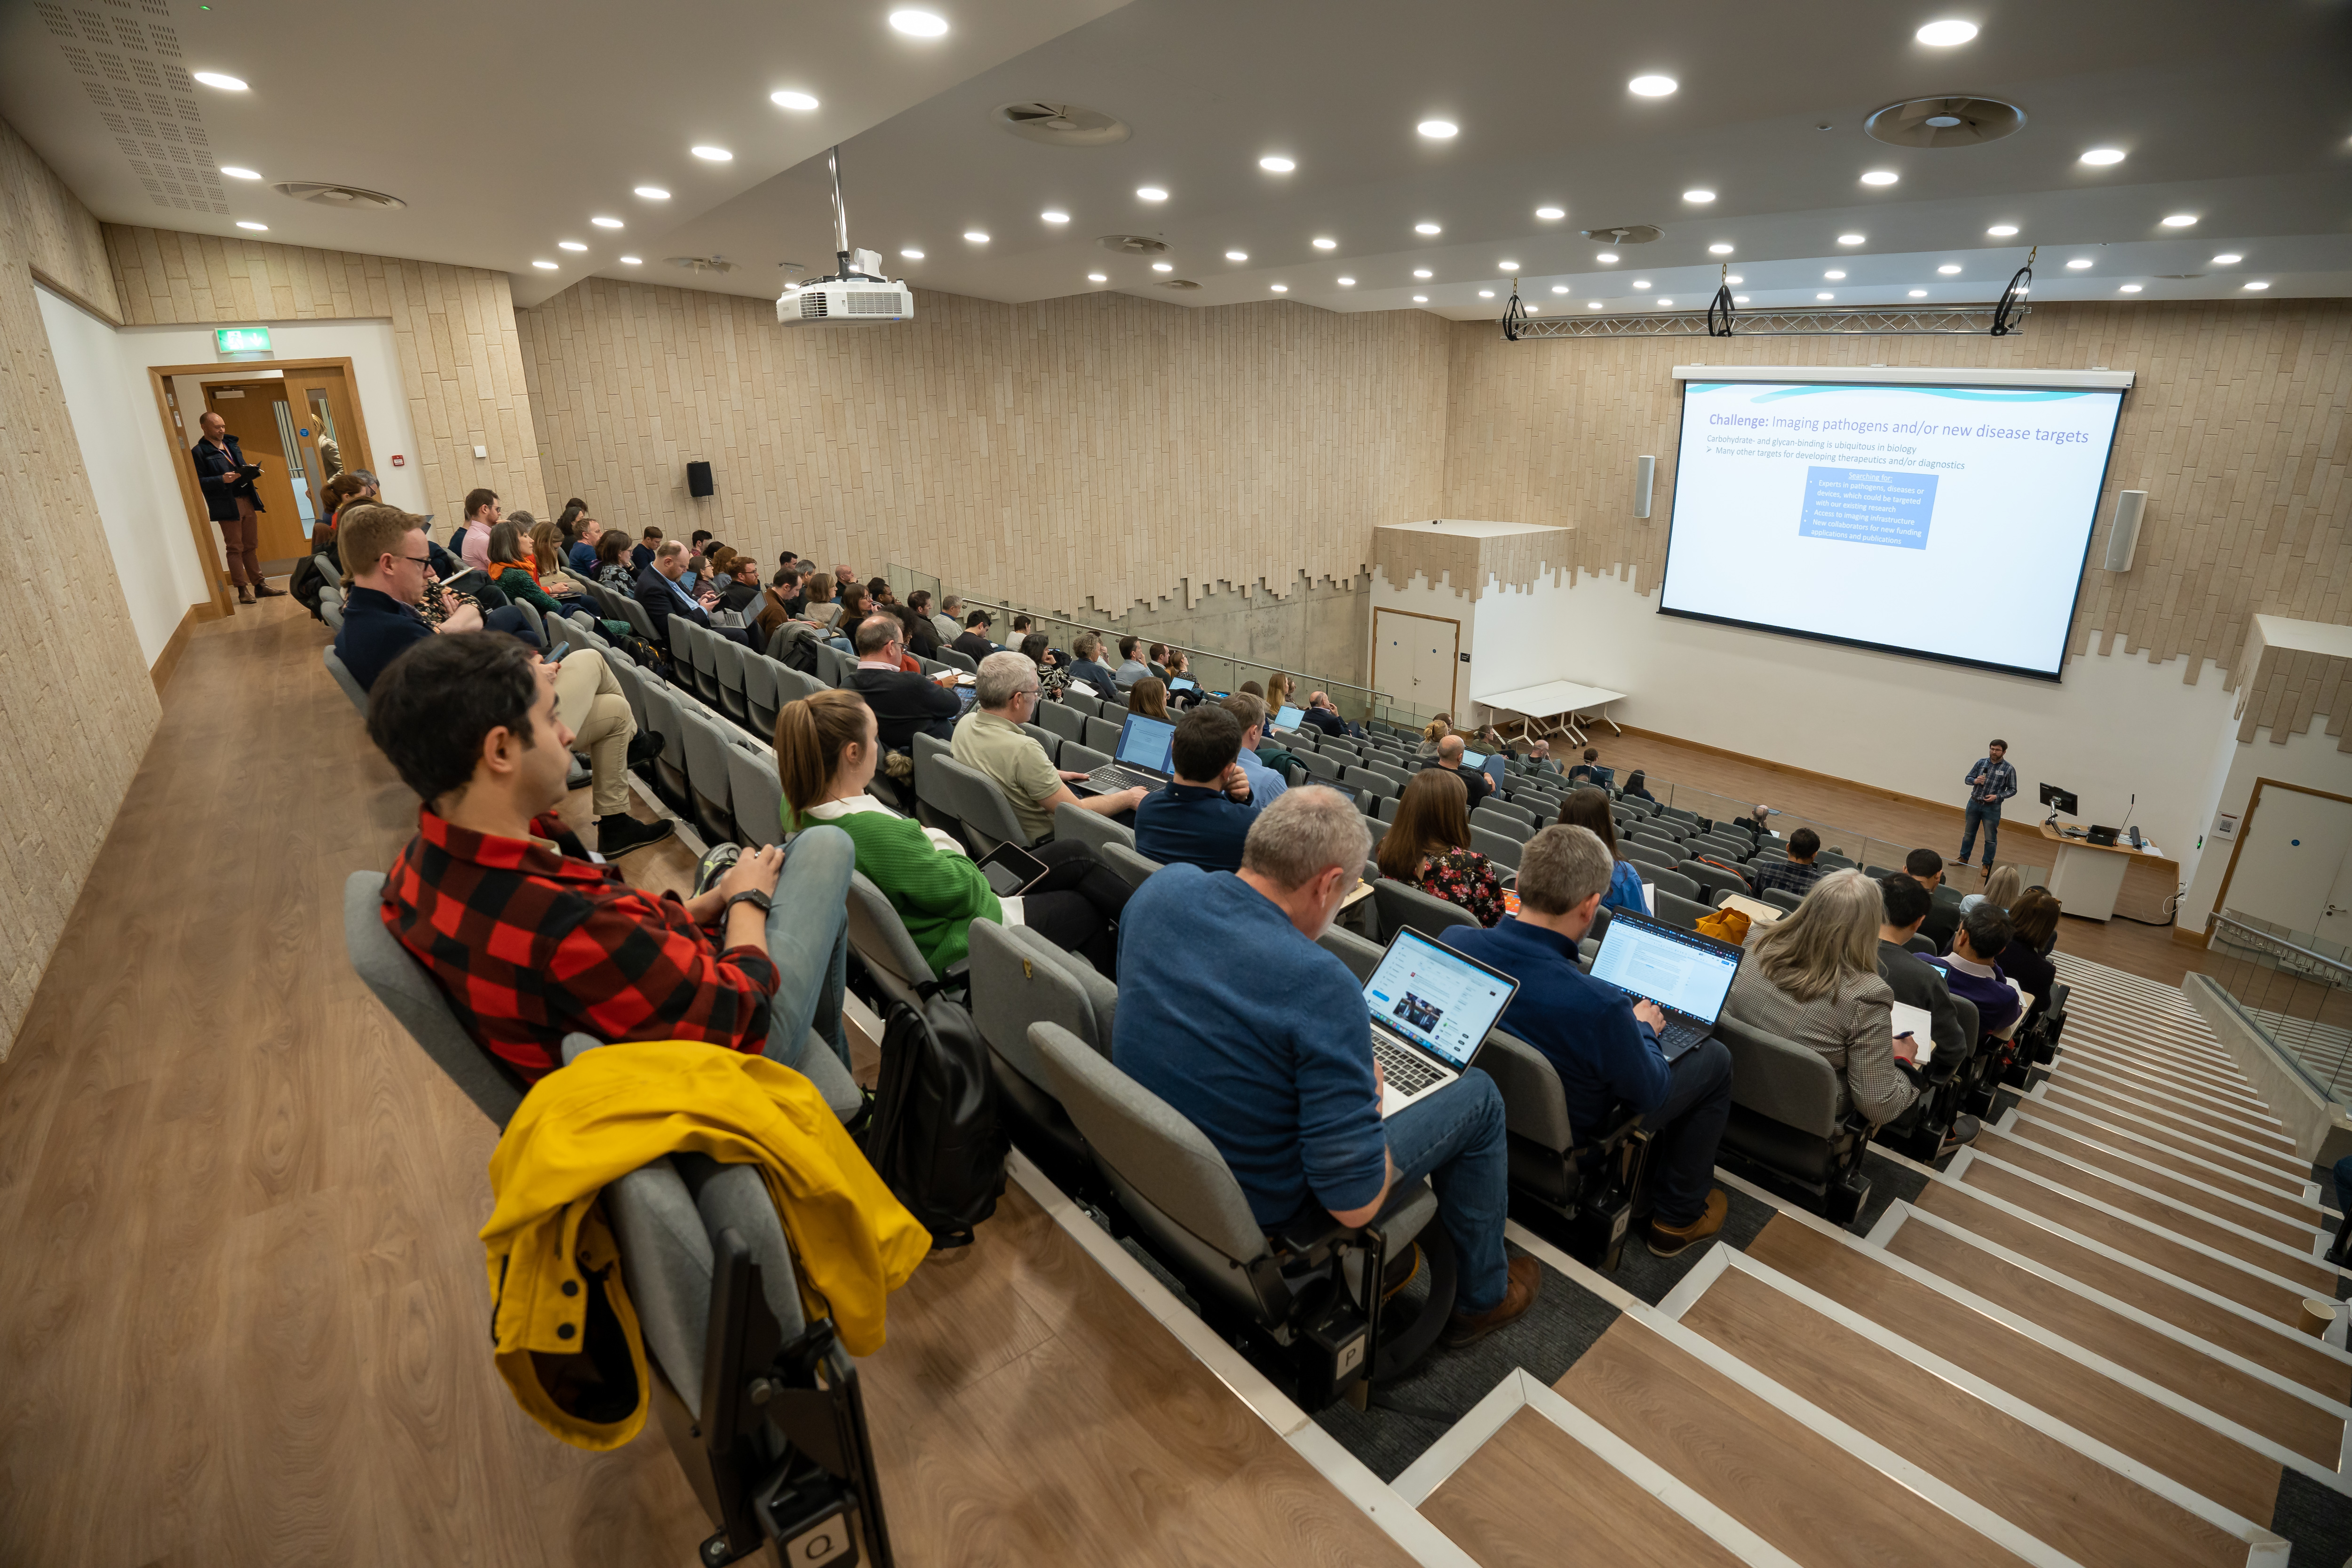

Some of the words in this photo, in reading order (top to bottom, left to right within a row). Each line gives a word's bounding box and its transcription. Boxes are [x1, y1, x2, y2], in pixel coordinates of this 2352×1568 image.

[1709, 414, 1769, 429] Challenge:
[1772, 416, 1819, 431] Imaging
[1822, 418, 1888, 434] pathogens
[1892, 421, 1939, 436] and/or
[1942, 426, 1972, 436] new
[1976, 424, 2030, 439] disease
[2035, 428, 2089, 444] targets
[1707, 435, 1755, 445] Carbohydrate-
[1772, 438, 1825, 449] glycan-binding
[1835, 441, 1875, 451] ubiquitous
[1887, 444, 1917, 454] biology
[1716, 447, 1735, 456] Many
[1757, 449, 1781, 458] targets
[1796, 451, 1836, 462] developing
[1838, 454, 1886, 464] therapeutics
[1889, 457, 1916, 467] and/or
[1918, 458, 1965, 470] diagnostics
[1848, 472, 1880, 481] Searching
[1819, 479, 1841, 488] Experts
[1850, 483, 1886, 493] pathogens,
[1887, 485, 1915, 493] diseases
[1817, 489, 1841, 499] devices,
[1893, 496, 1921, 505] targeted
[1843, 502, 1867, 511] existing
[1868, 504, 1896, 513] research
[1844, 512, 1869, 522] imaging
[1870, 514, 1915, 525] infrastructure
[1811, 529, 1848, 539] applications
[1862, 534, 1901, 545] publications
[1828, 521, 1868, 531] collaborators
[1896, 527, 1922, 538] funding
[1345, 1348, 1356, 1366] P
[806, 1534, 835, 1560] Q
